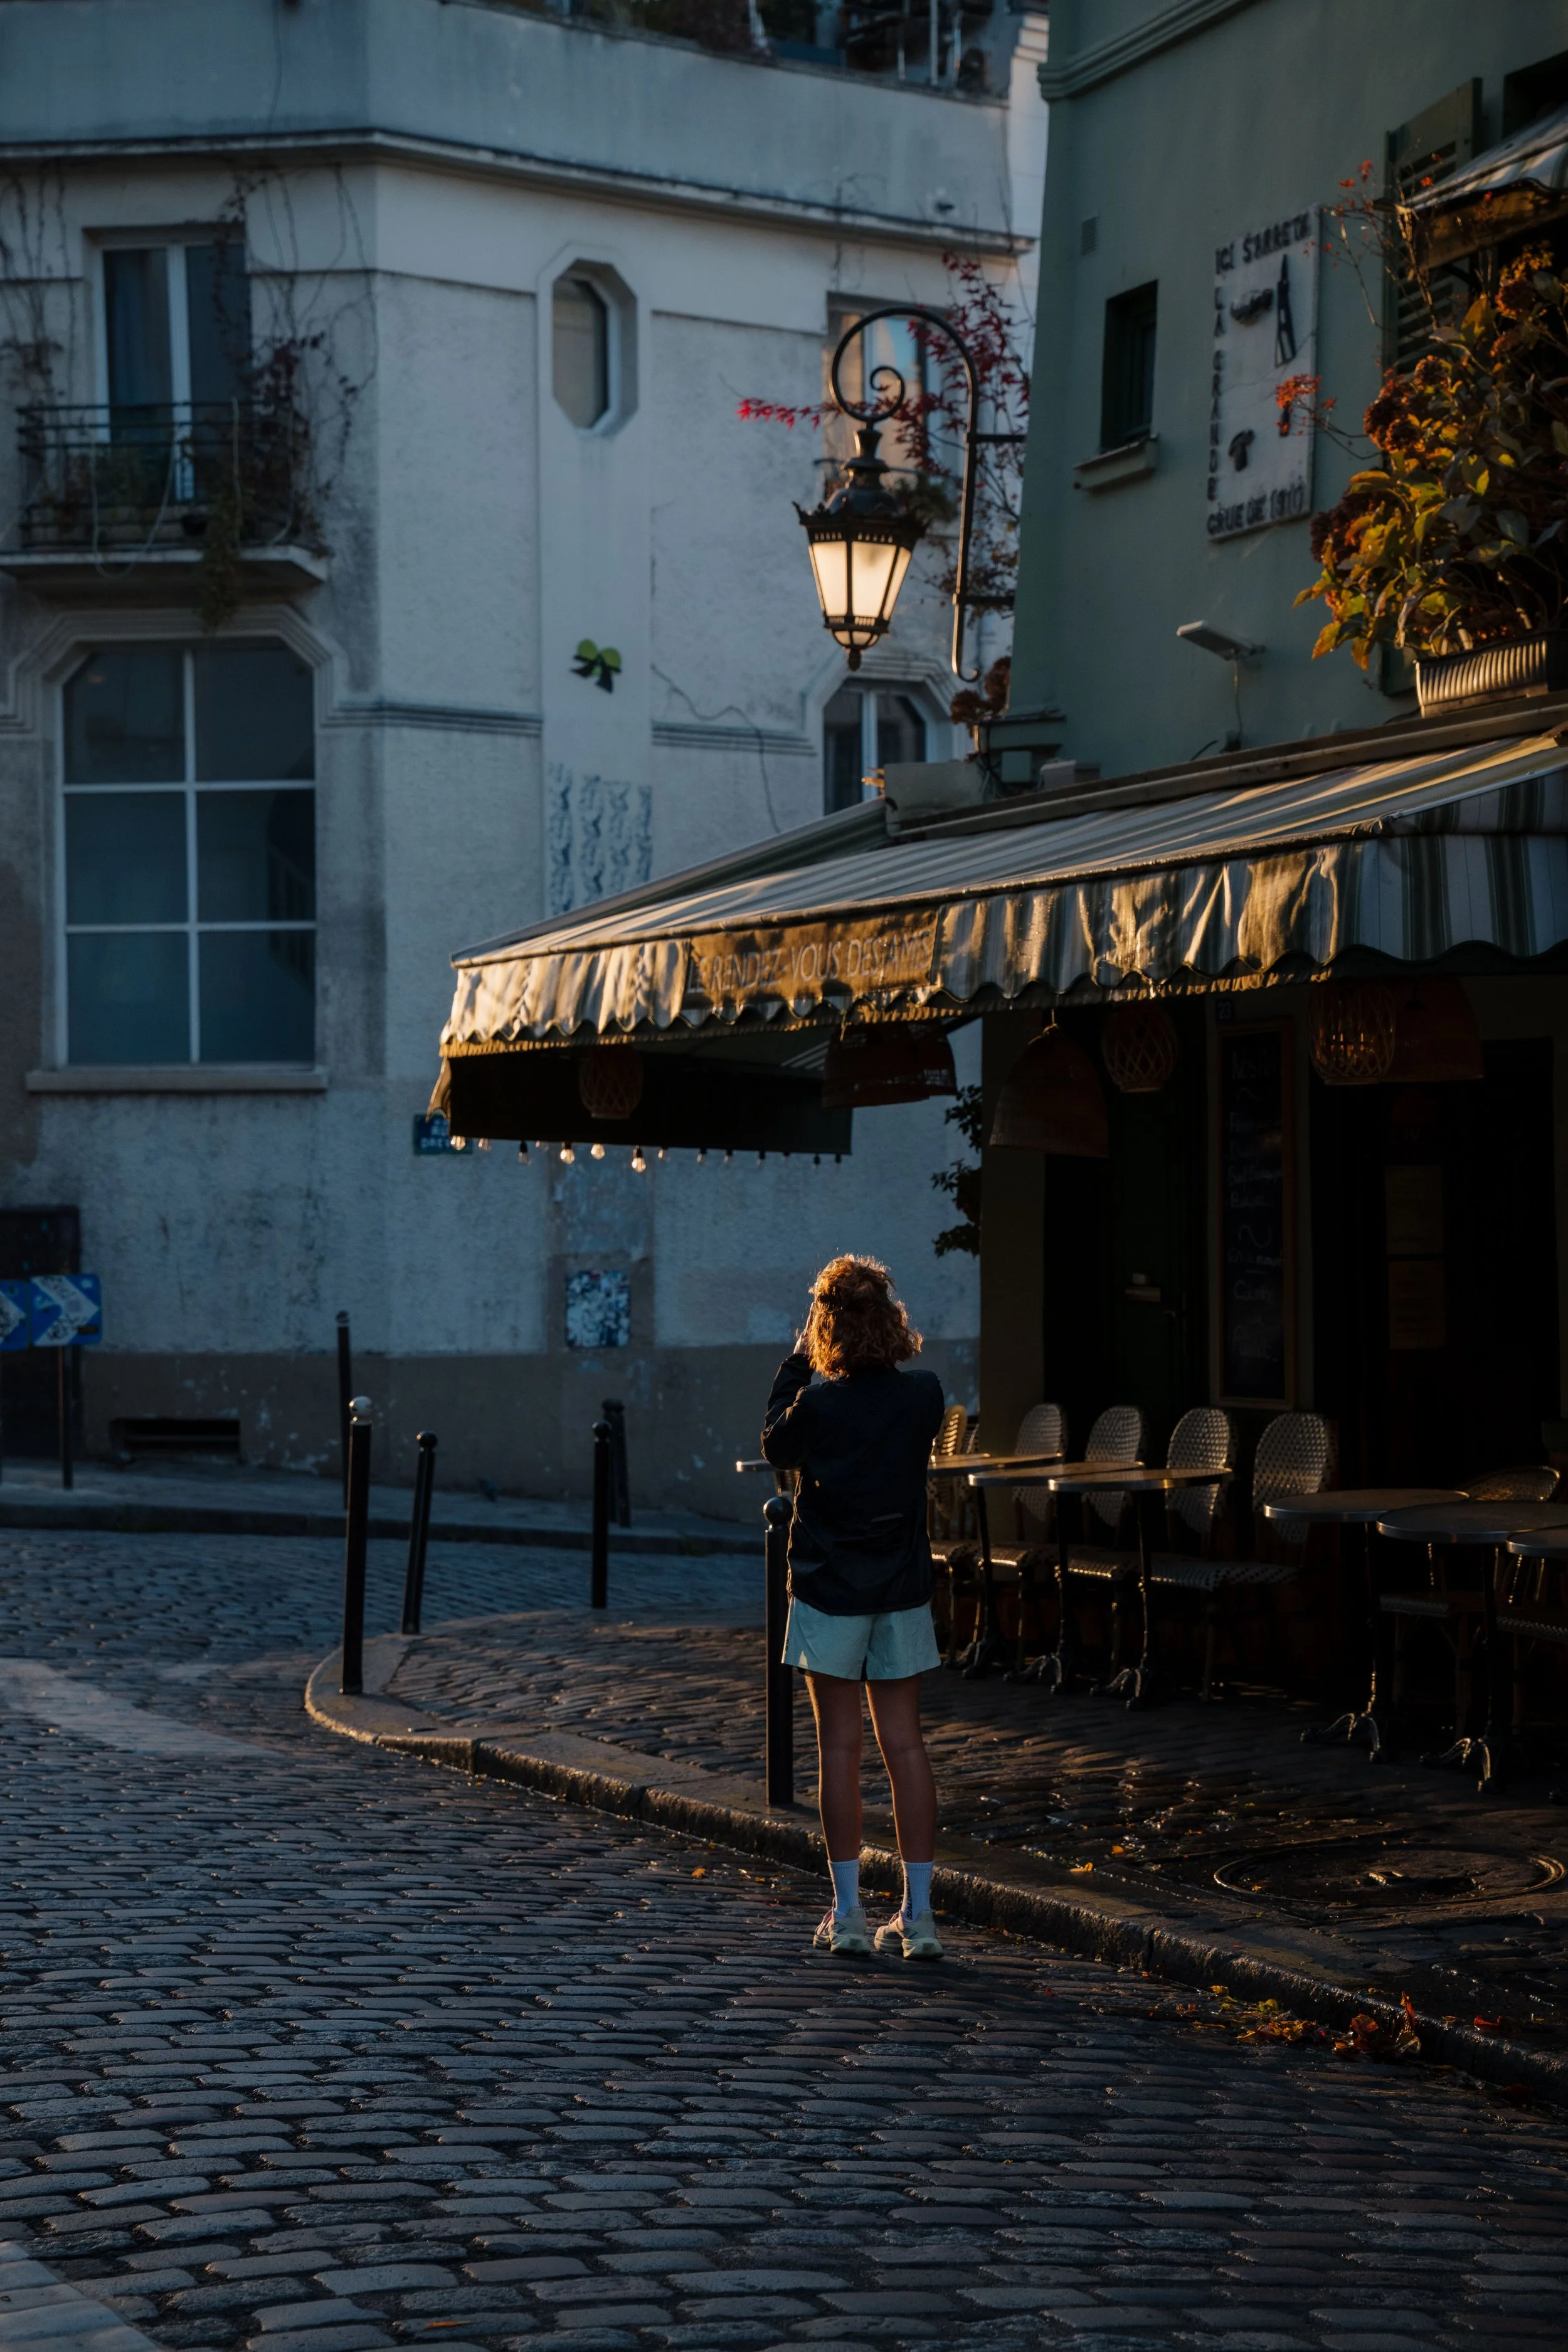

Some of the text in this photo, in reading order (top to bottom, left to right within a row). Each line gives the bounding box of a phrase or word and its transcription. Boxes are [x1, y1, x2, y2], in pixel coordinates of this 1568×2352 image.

[1215, 241, 1235, 275] ICI
[1207, 502, 1244, 535] CRUE
[1247, 494, 1267, 525] DE
[847, 936, 880, 977] DES
[884, 930, 932, 972] AMIS
